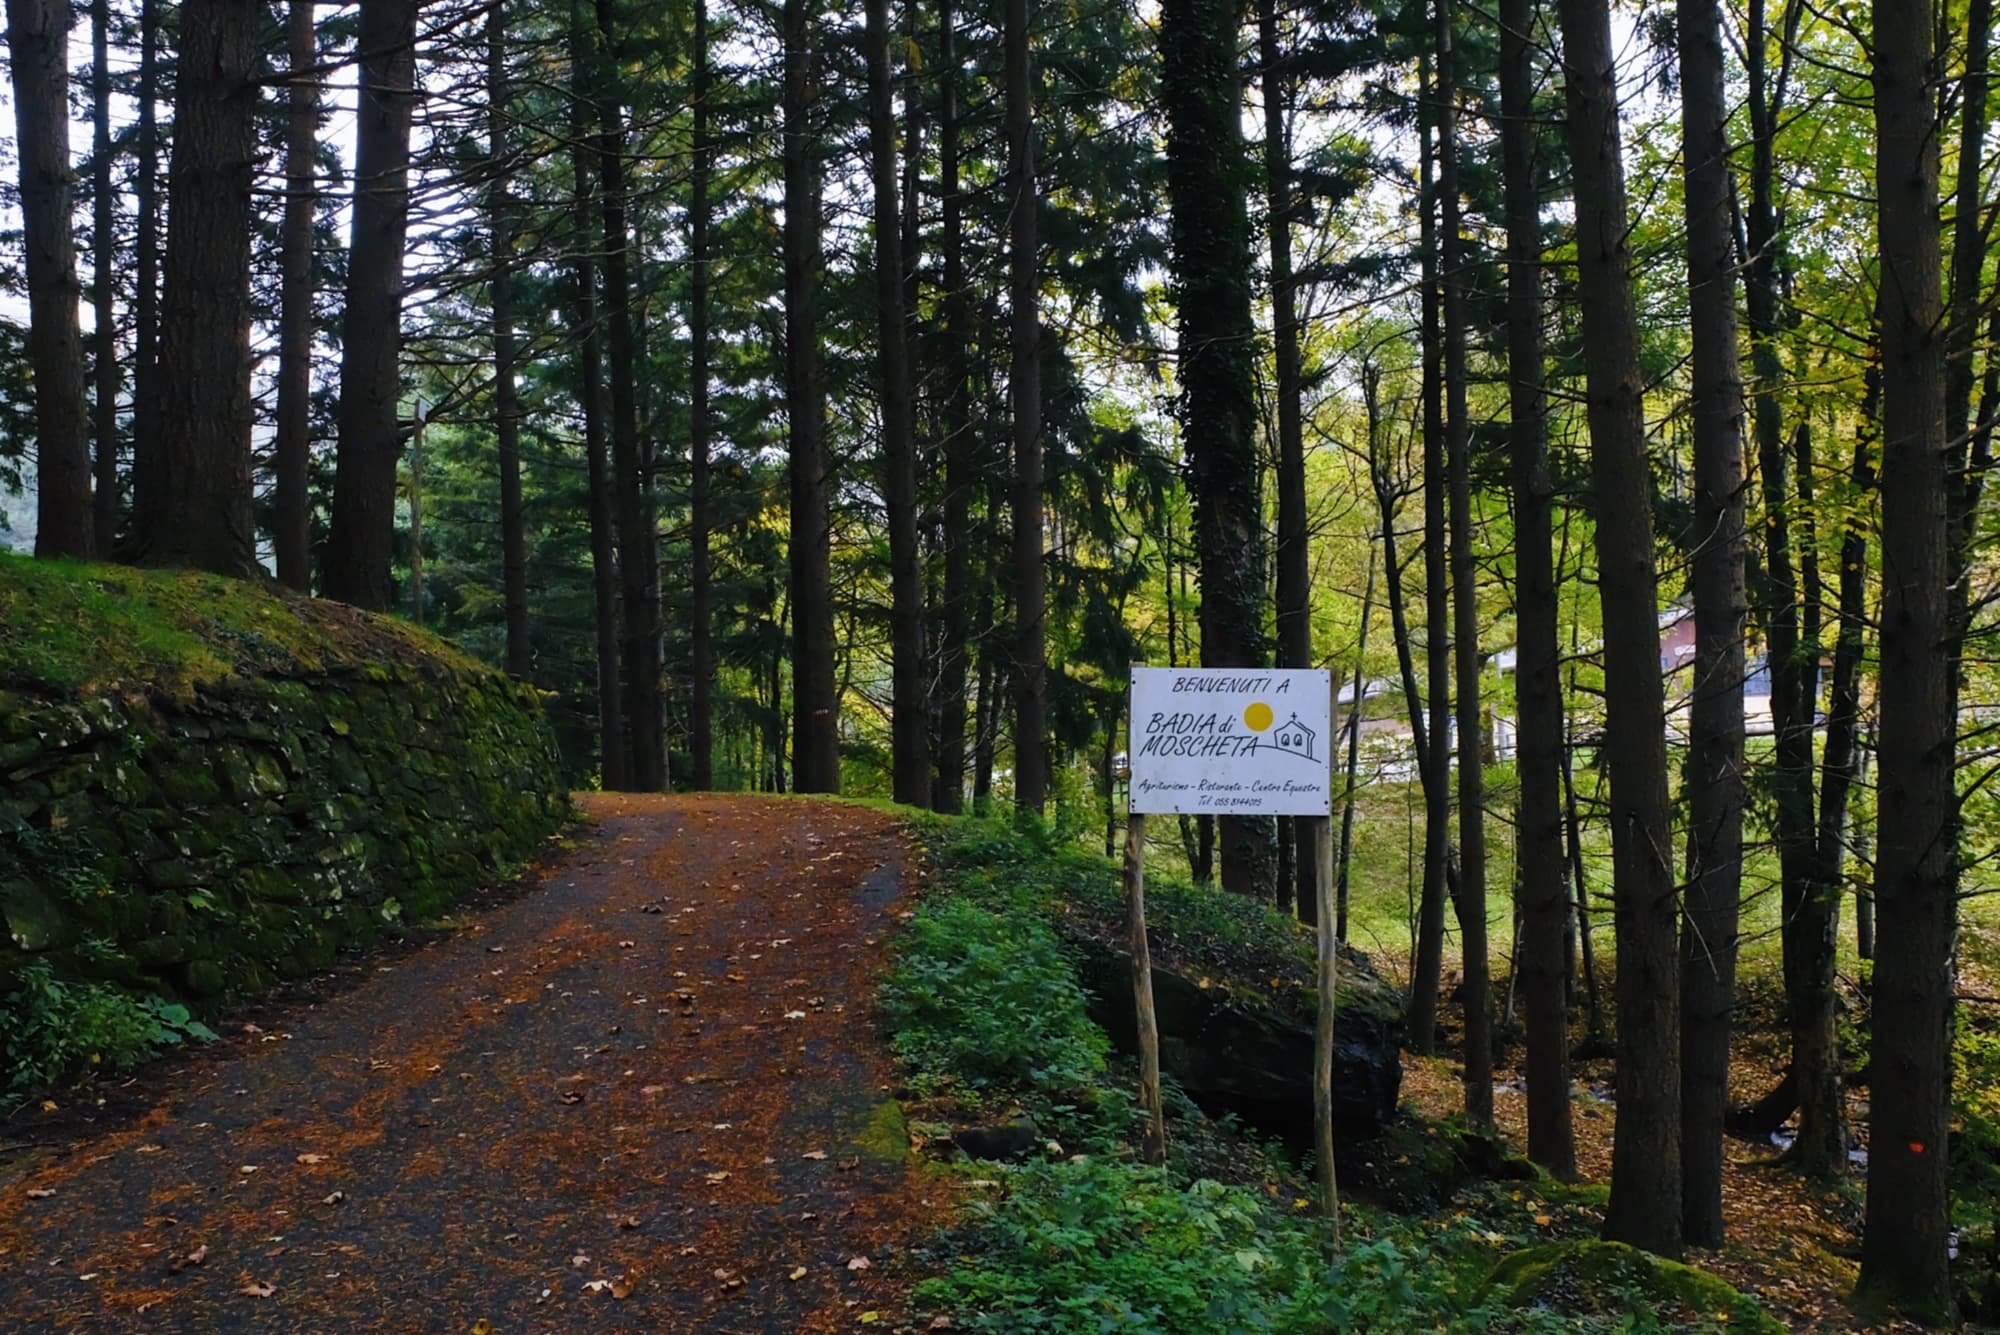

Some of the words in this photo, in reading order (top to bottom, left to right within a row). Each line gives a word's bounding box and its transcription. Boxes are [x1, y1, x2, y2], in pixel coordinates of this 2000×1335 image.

[1172, 677, 1271, 693] BENVENUTI
[1276, 679, 1290, 693] A
[1146, 713, 1217, 734] BADIA
[1219, 715, 1237, 733] di
[1139, 735, 1259, 757] MOSCHETA
[1139, 779, 1189, 794] Agriturismo
[1198, 779, 1242, 792] Ristorante
[1252, 780, 1281, 792] Centro
[1283, 781, 1320, 796] Equestre
